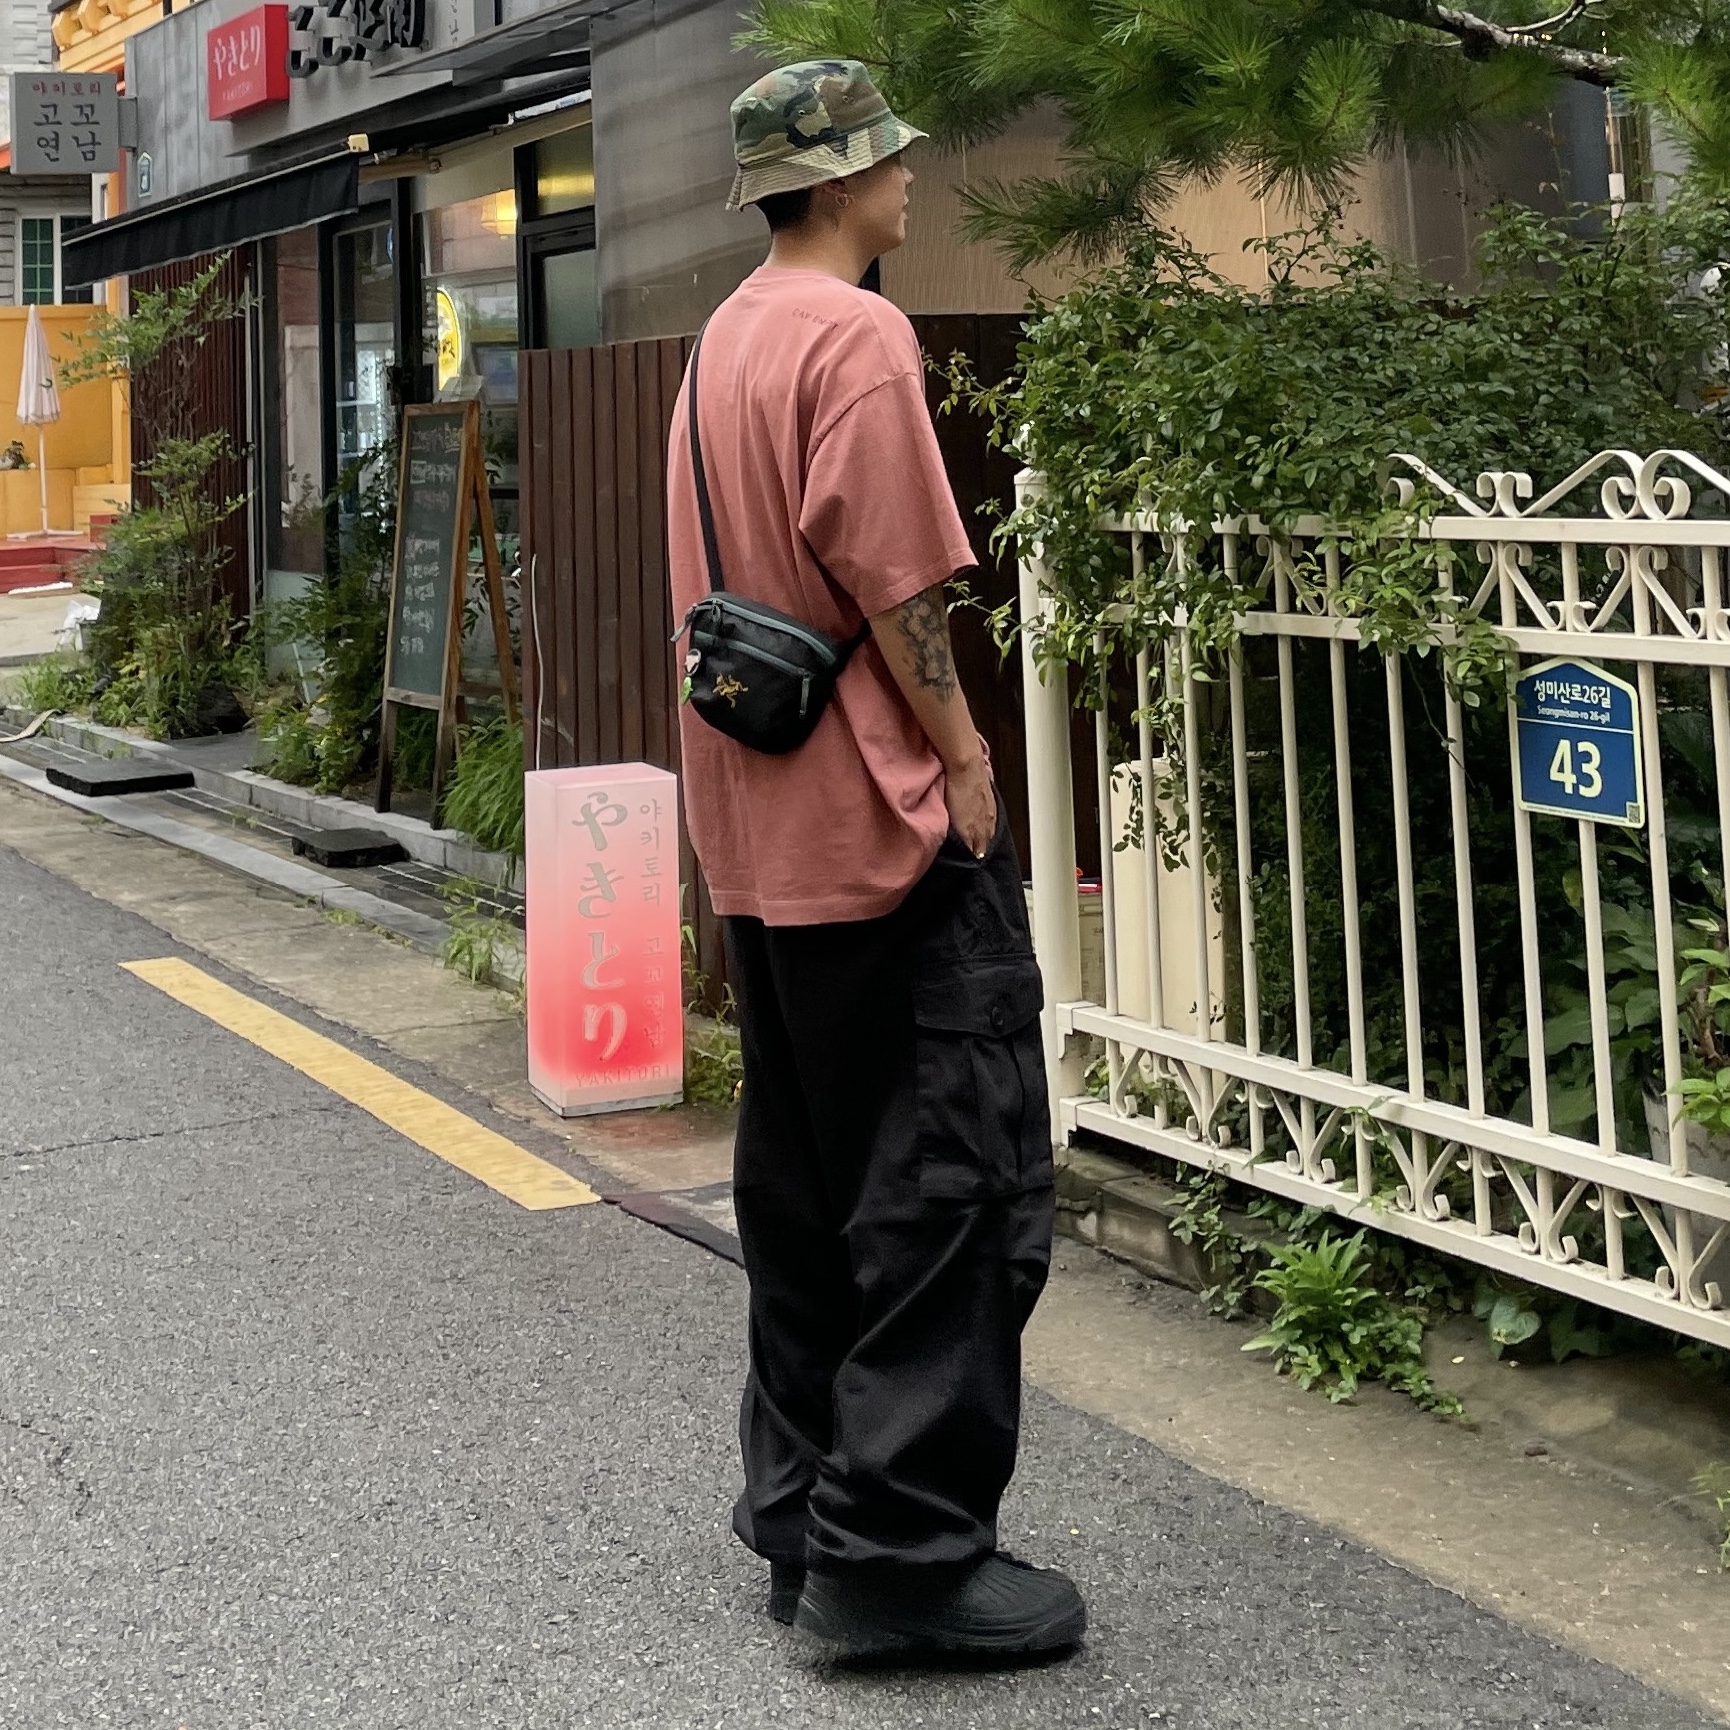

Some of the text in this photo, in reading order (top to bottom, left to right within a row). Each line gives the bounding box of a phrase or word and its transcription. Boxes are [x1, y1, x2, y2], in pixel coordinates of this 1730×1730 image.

[213, 25, 261, 81] やきとり
[33, 103, 101, 127] 고꼬
[36, 130, 102, 162] 연남
[1533, 680, 1612, 709] 성미산로26길
[1550, 739, 1603, 798] 43
[640, 798, 663, 907] 야키토리
[572, 791, 629, 1062] やきとり
[575, 1064, 671, 1088] YAKITORI
